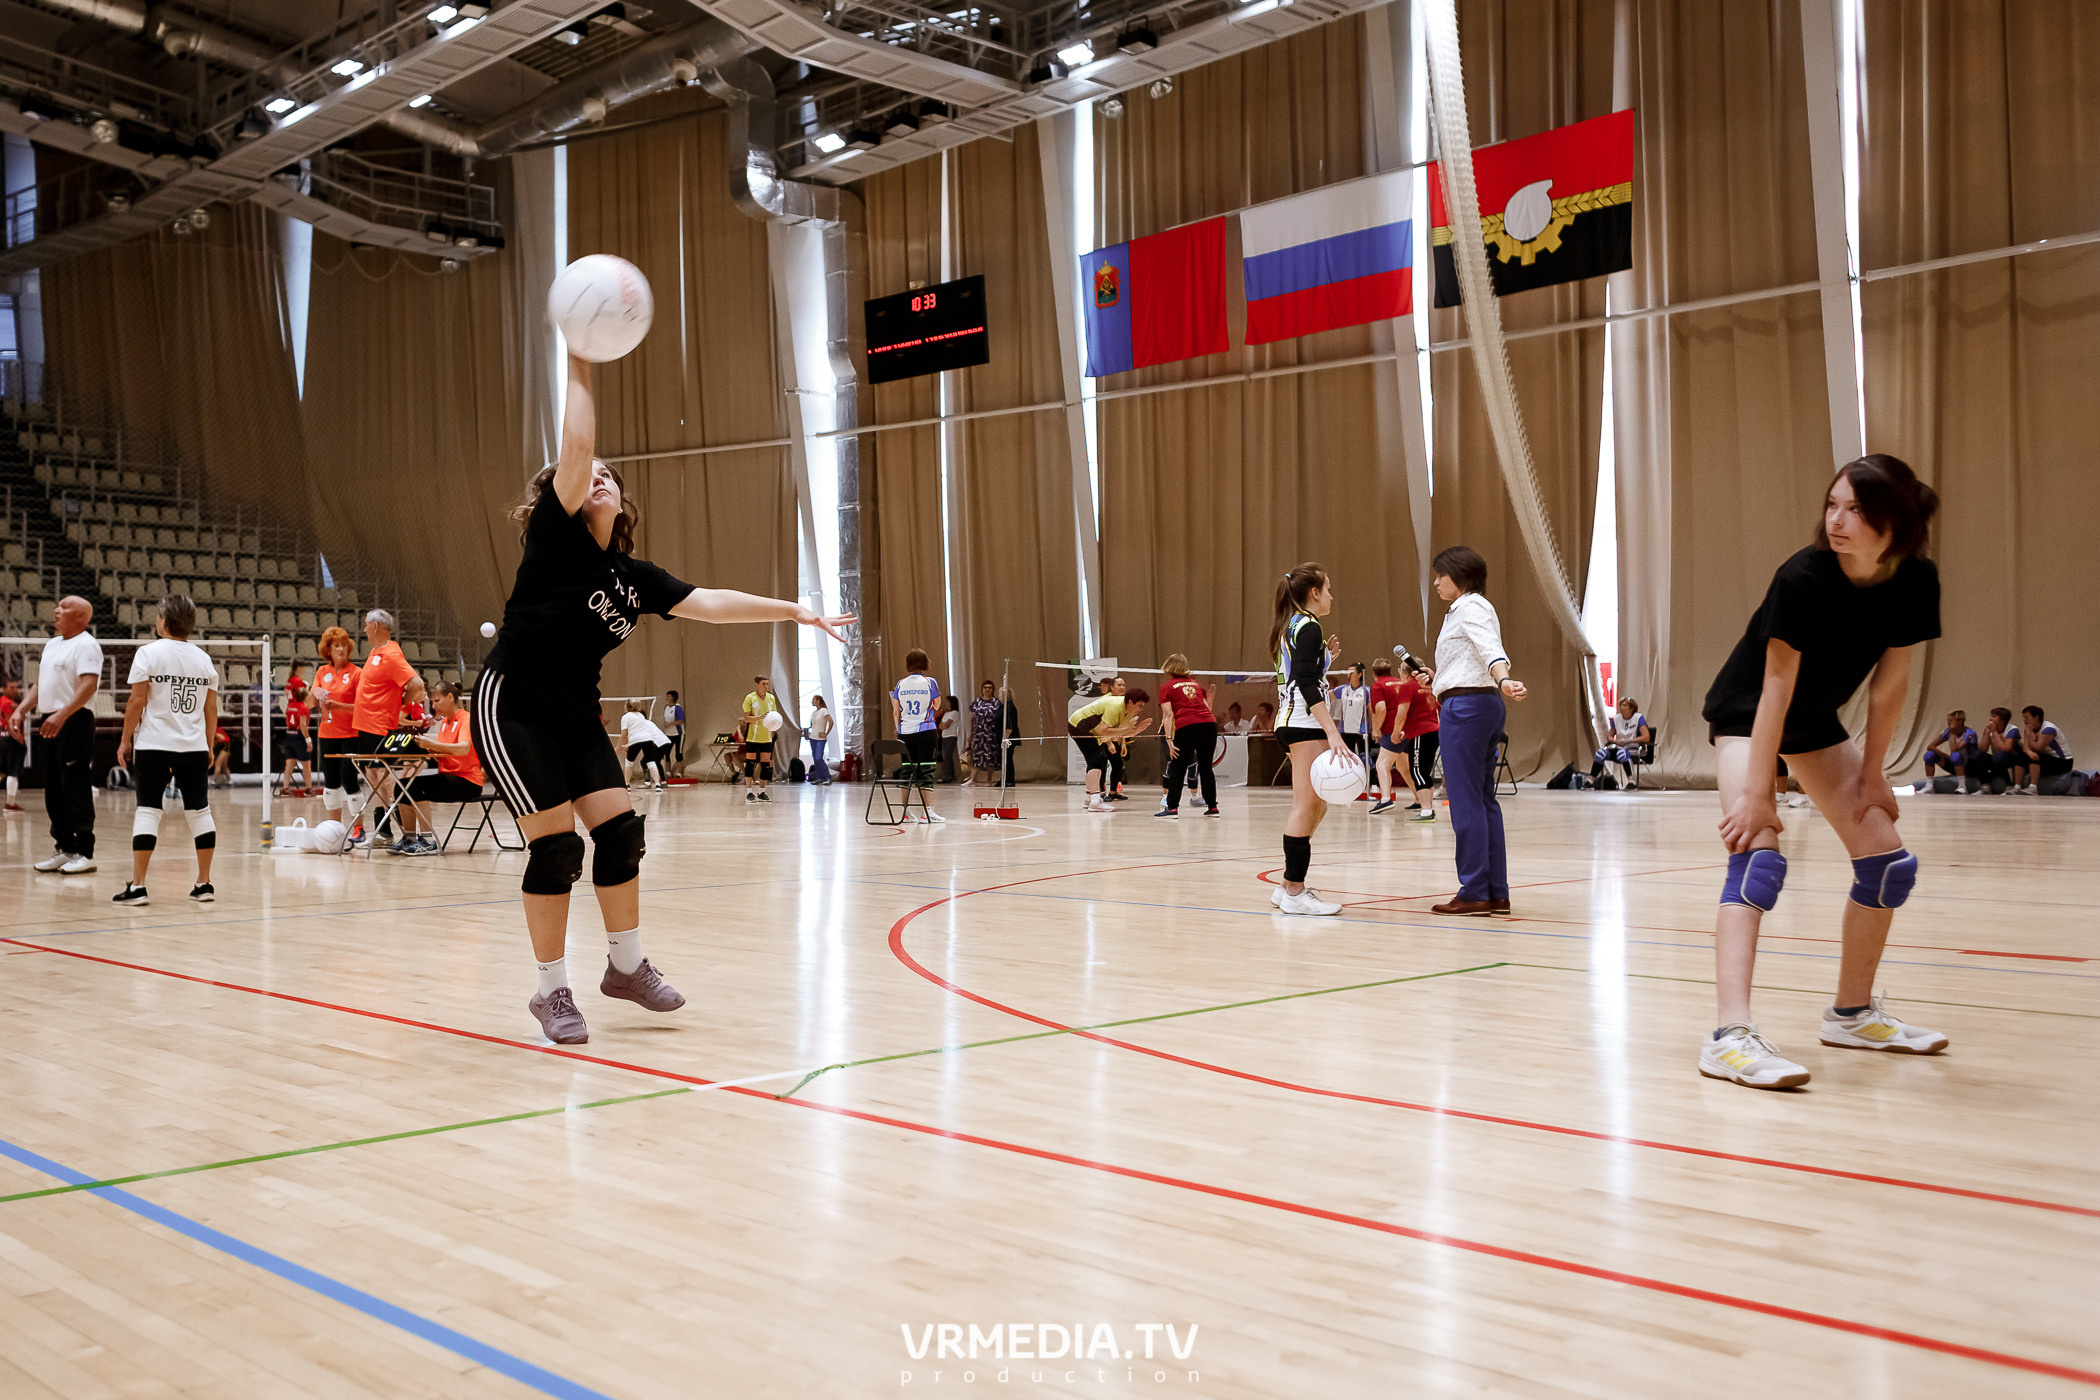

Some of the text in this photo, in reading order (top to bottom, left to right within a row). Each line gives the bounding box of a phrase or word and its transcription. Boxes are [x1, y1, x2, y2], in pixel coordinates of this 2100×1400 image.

[149, 675, 212, 686] ГОРБУНОВ
[171, 684, 197, 714] 55
[906, 700, 920, 715] 13
